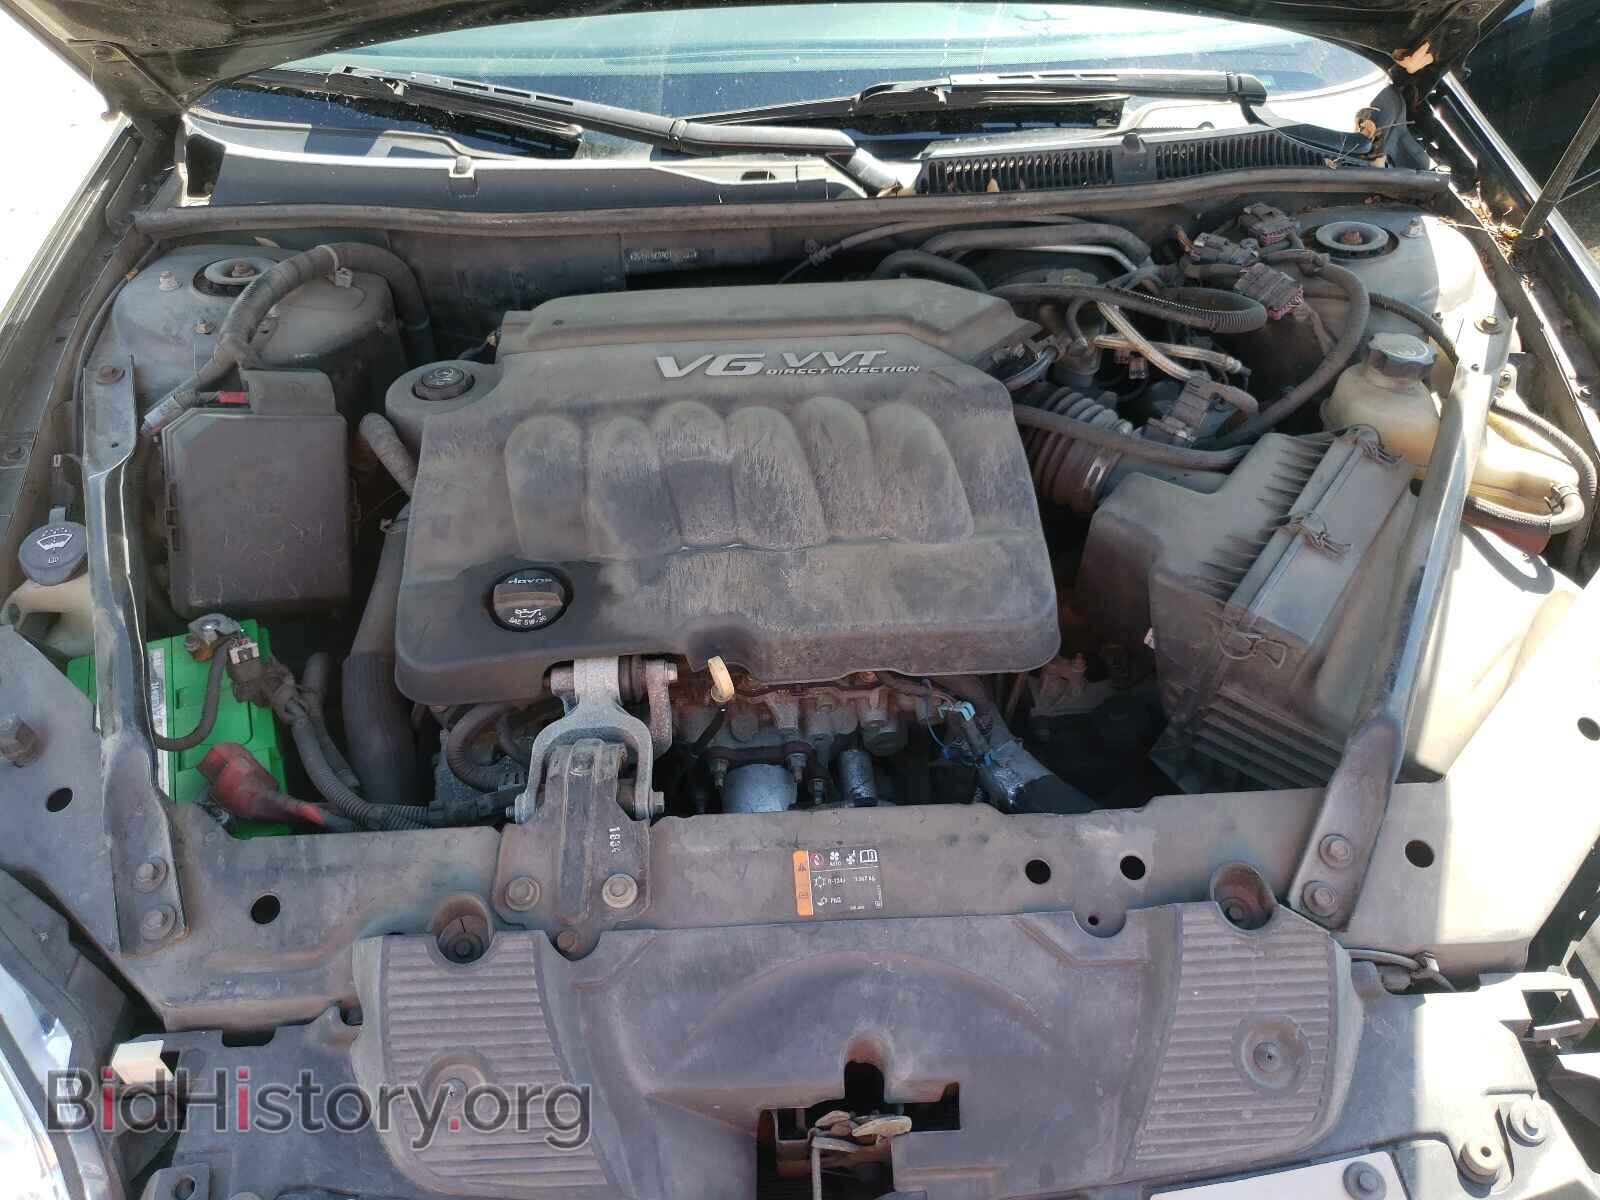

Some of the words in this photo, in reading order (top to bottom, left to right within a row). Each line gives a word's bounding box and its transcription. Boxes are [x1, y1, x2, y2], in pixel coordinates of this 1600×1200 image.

[656, 353, 766, 378] V6
[782, 350, 887, 368] VVT
[766, 367, 826, 376] DIRECT
[832, 365, 921, 375] INJECTION
